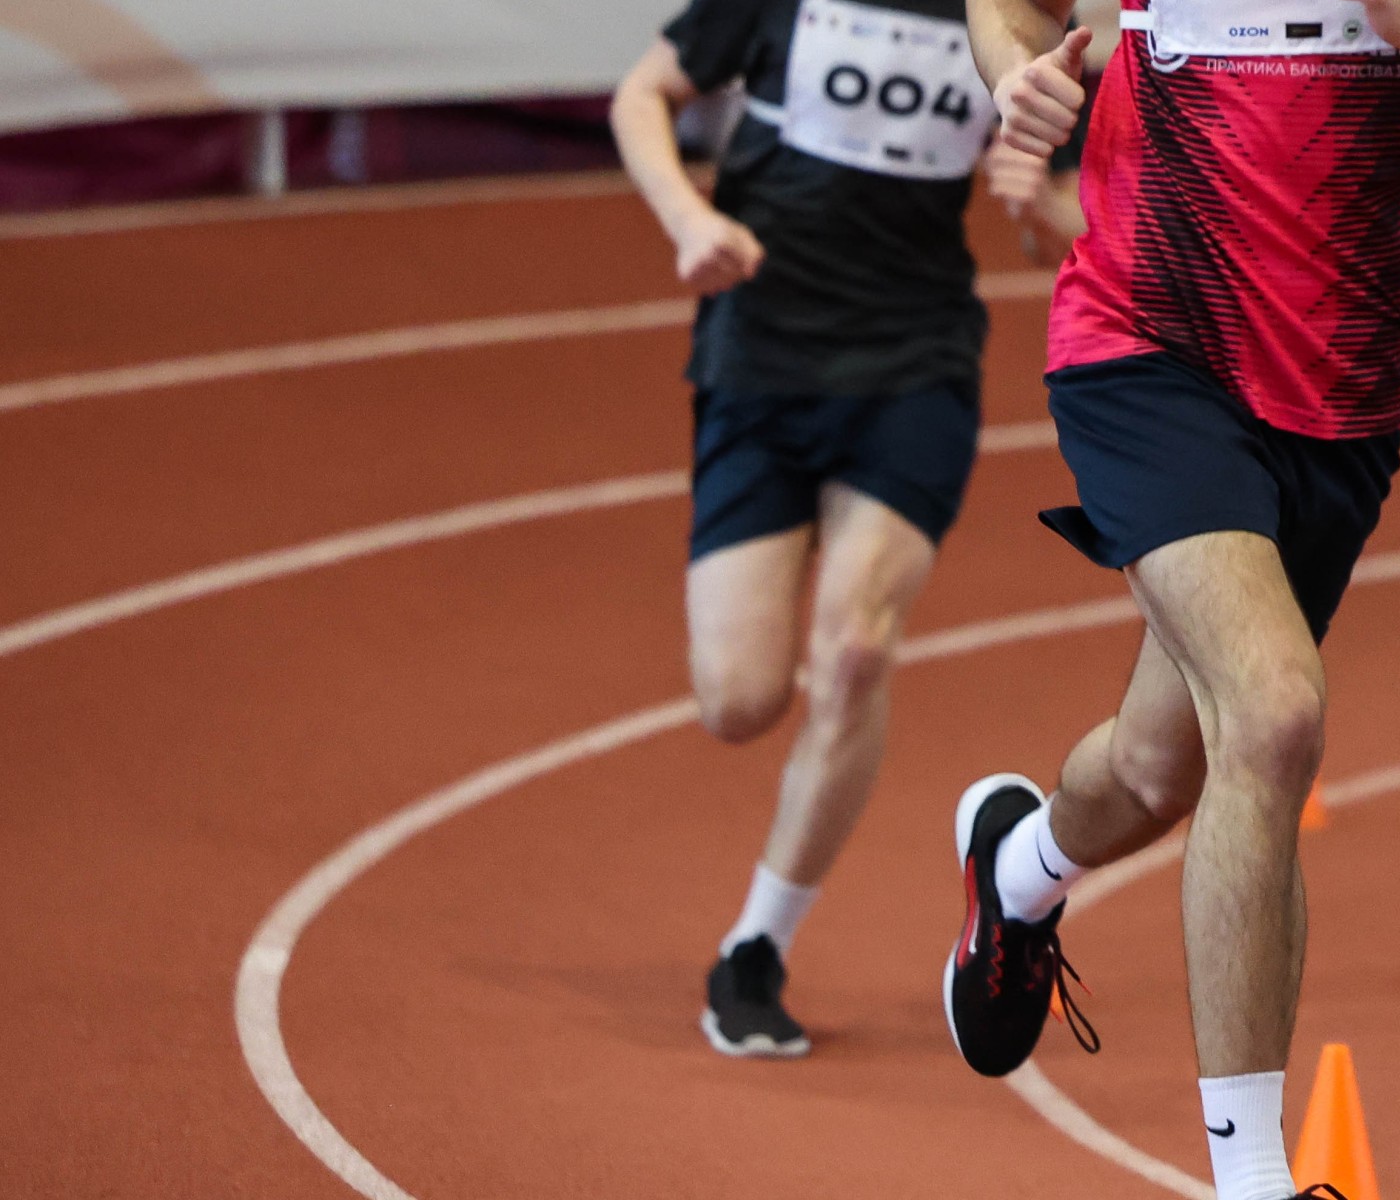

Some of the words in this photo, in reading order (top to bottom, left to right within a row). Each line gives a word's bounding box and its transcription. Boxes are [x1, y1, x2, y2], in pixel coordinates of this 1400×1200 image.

[1206, 57, 1286, 76] ПРАКТИКА
[1289, 63, 1397, 78] БАНКРОТСТВА
[825, 64, 971, 126] 004
